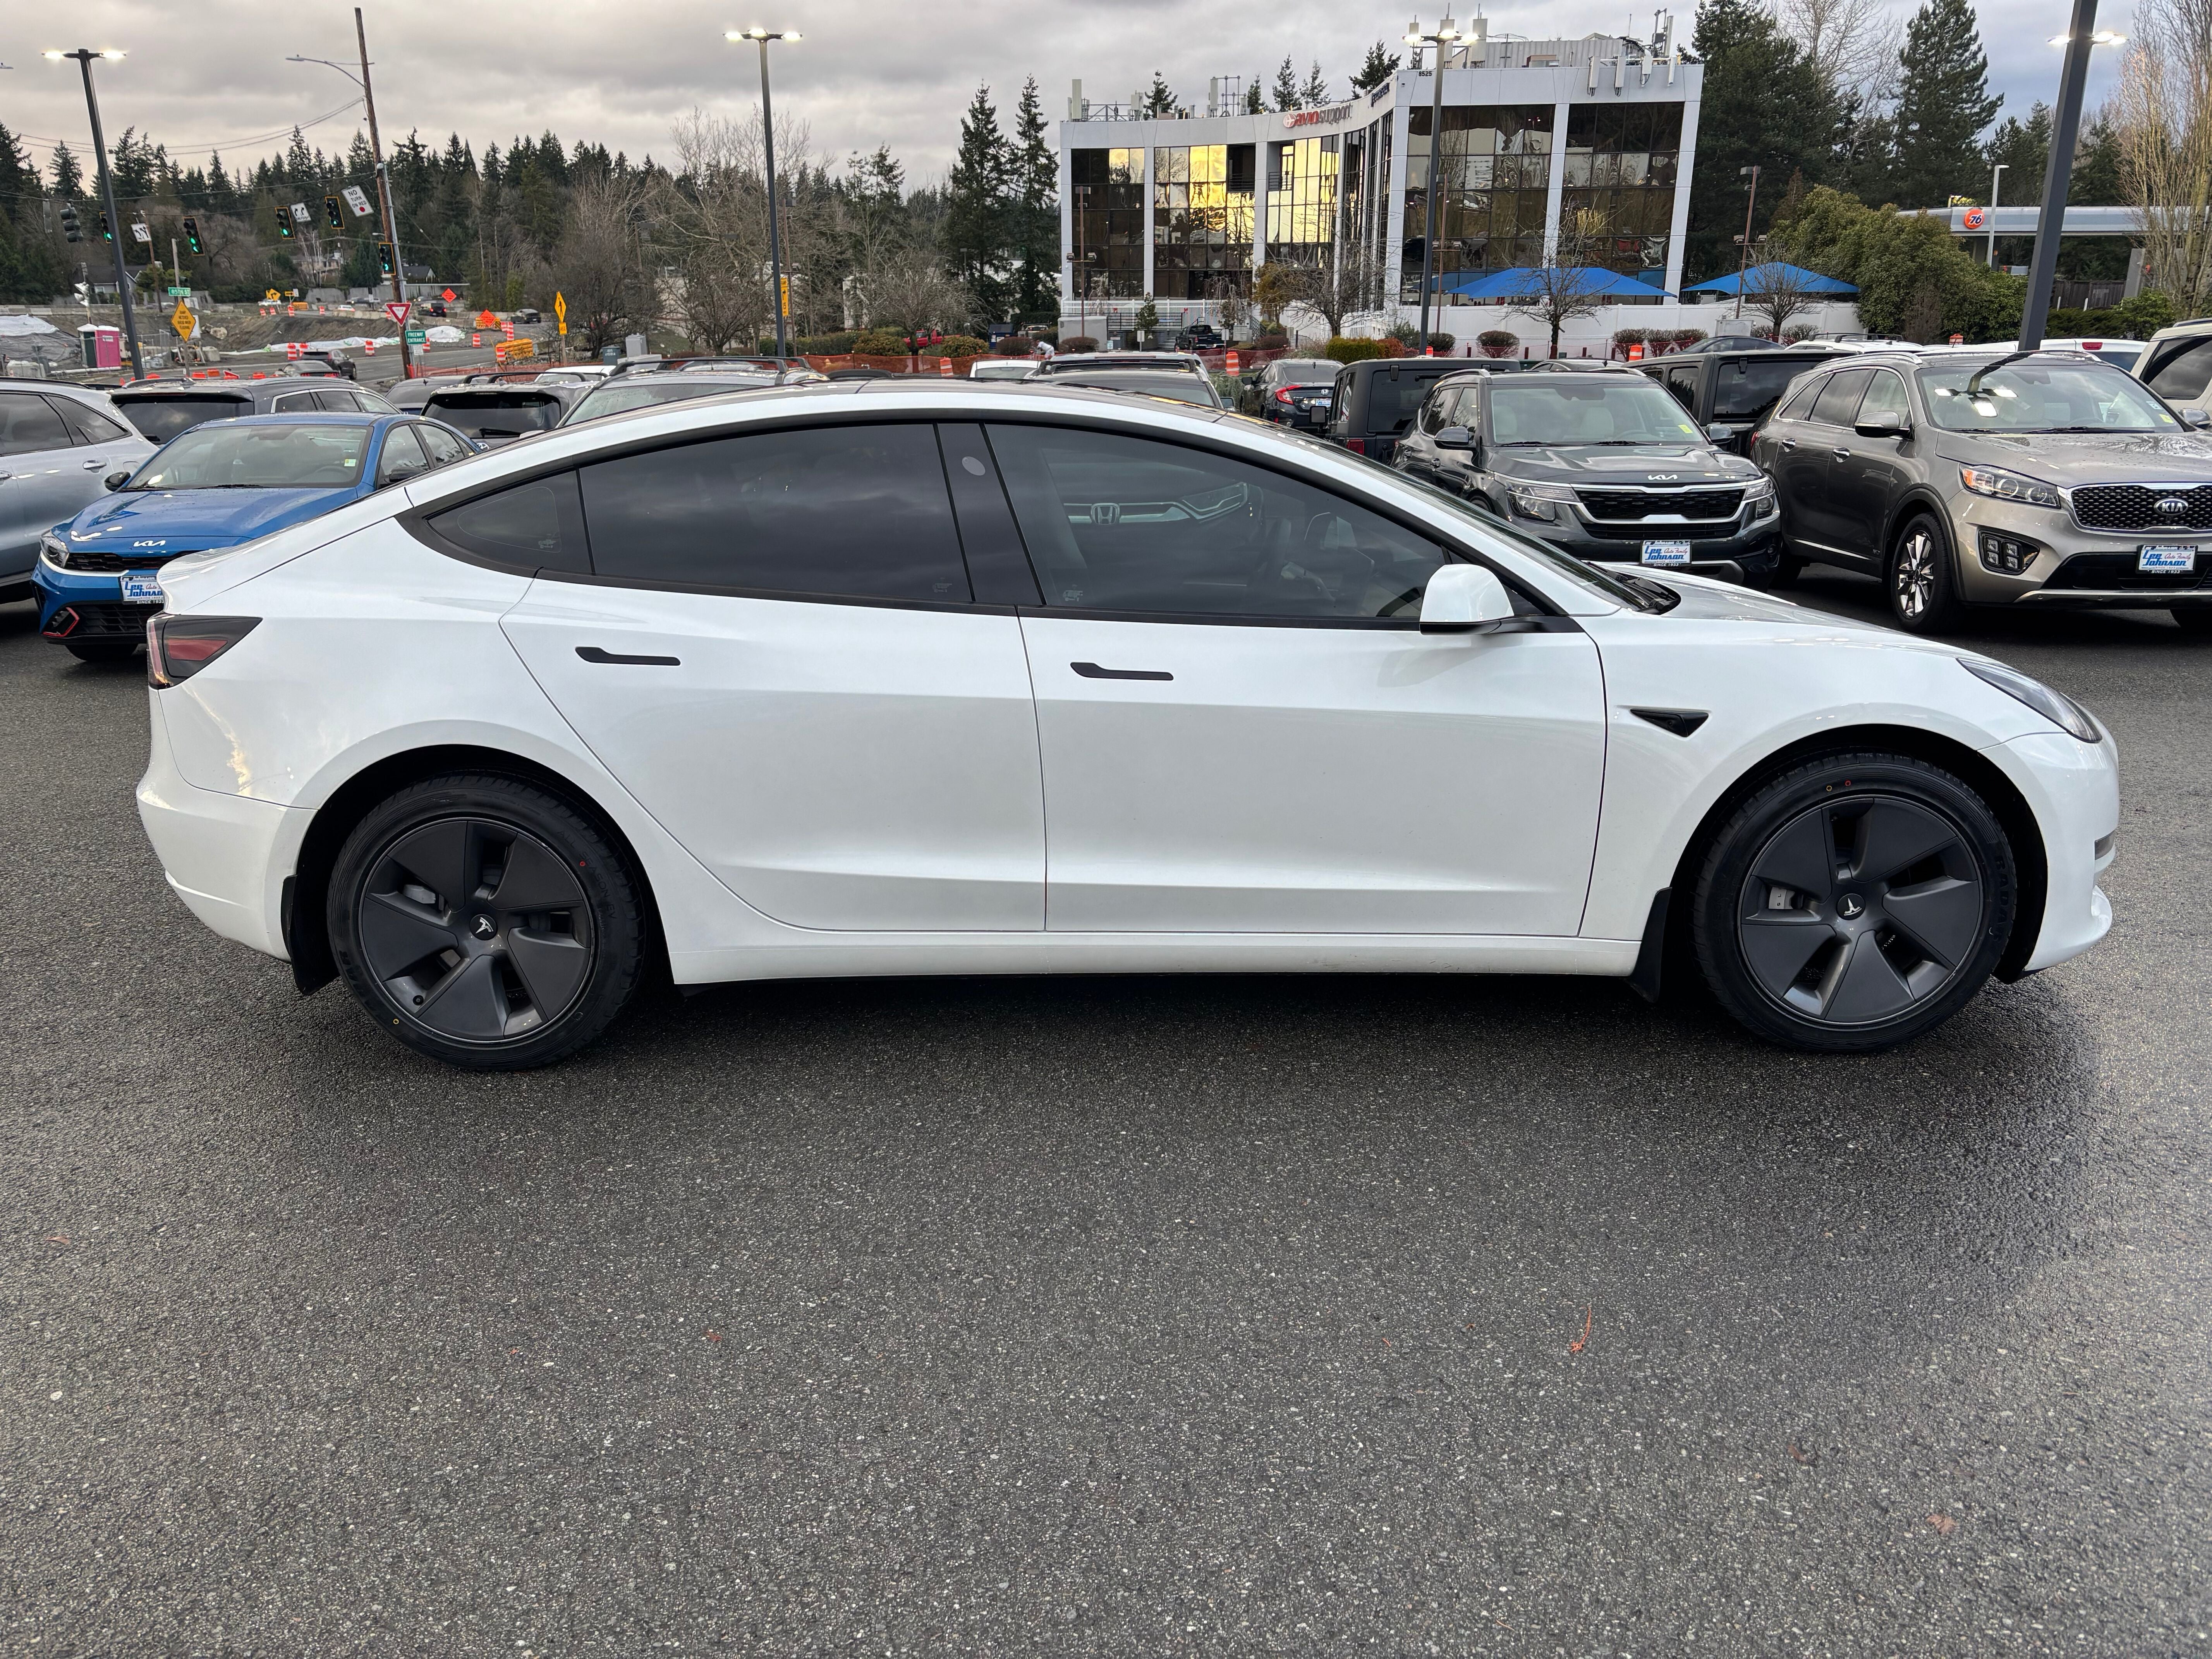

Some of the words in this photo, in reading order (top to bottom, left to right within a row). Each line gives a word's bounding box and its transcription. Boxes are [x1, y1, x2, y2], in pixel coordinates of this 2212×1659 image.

[1968, 213, 1983, 225] 76
[2162, 502, 2183, 512] KIA
[1645, 546, 1662, 554] Lee
[2142, 550, 2162, 559] Lee
[125, 582, 144, 590] Lee
[579, 851, 611, 898] SEASON
